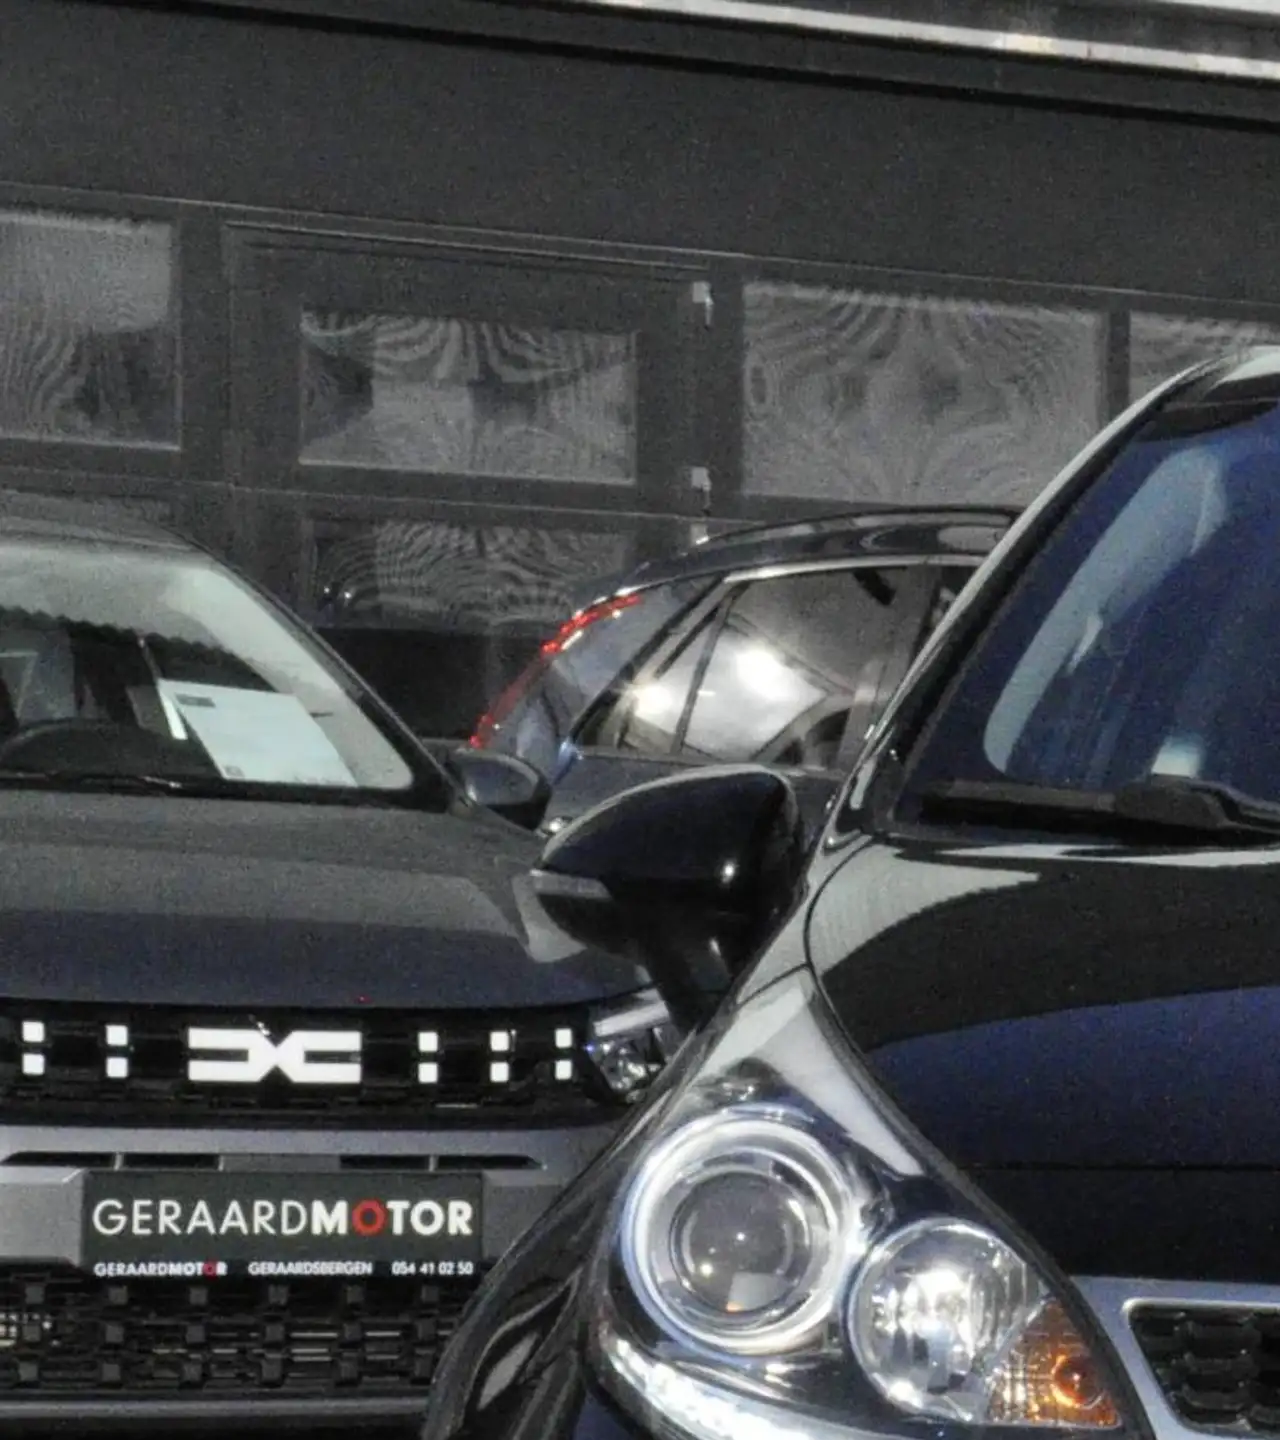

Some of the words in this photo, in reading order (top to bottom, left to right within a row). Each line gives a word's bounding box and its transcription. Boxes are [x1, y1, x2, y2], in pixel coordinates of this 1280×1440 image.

[92, 1198, 473, 1236] GERAARDMOTOR
[94, 1261, 228, 1278] GERAARDMOTOR
[248, 1261, 373, 1276] GERAARDSBERGEN
[391, 1260, 416, 1276] 054
[419, 1261, 435, 1276] 41
[438, 1261, 455, 1276] 02
[457, 1261, 473, 1276] 50
